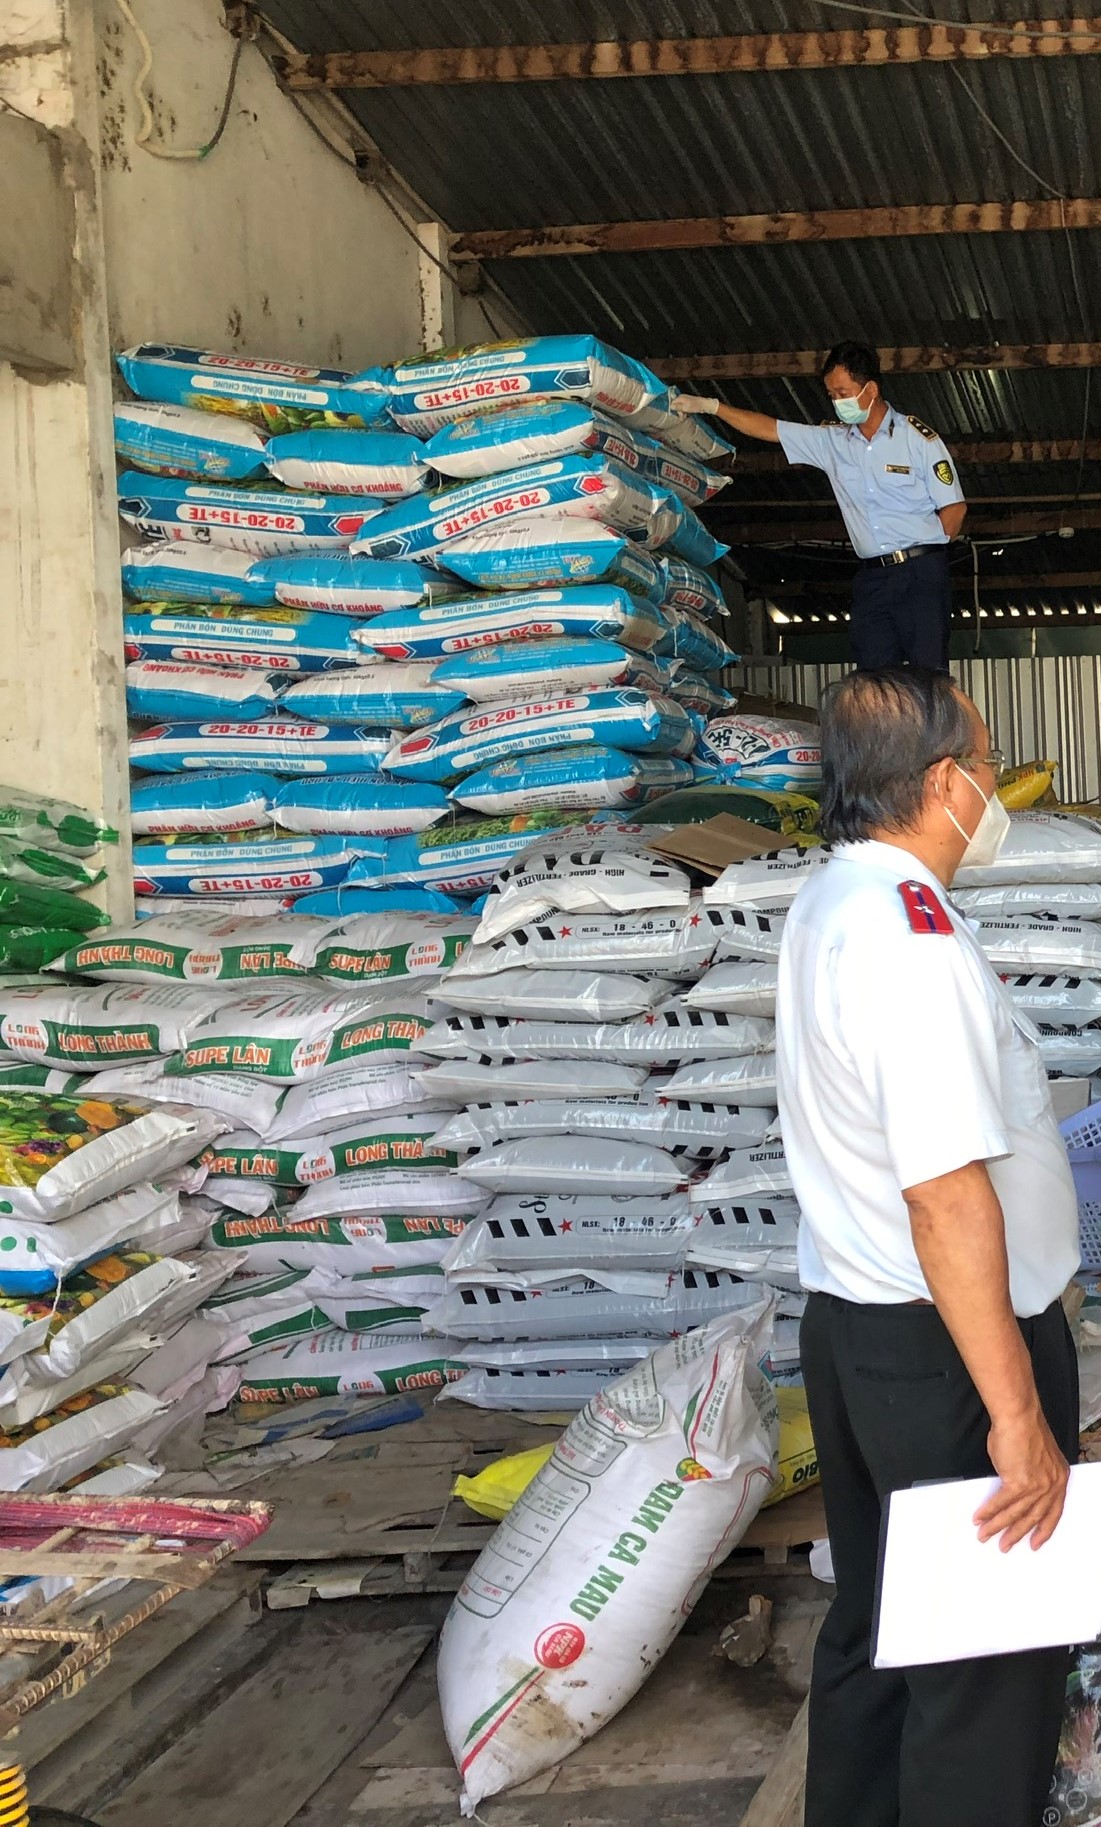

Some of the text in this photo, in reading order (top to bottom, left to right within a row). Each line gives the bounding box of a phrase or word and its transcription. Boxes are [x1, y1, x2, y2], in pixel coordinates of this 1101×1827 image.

[425, 378, 521, 407] 20-20-15+TE
[189, 506, 295, 530] 20-20-15+TE
[443, 492, 540, 535] 20-20-15+TE
[182, 650, 289, 668] 20-20-15+TE
[469, 698, 576, 731] 20-20-15+TE
[207, 724, 316, 736] 20-20-15+TE
[201, 873, 311, 891] 20-20-15+TE
[515, 868, 625, 888] HIGH GRADE FERTILIZER
[613, 922, 626, 932] 18
[979, 921, 1082, 933] HIGH GRADE FERTILIZE
[76, 944, 175, 969] LONG THÀNH
[411, 943, 438, 956] LONG
[240, 952, 271, 974] LÂN
[328, 951, 392, 974] SUPE LÂN
[7, 1023, 40, 1036] LONG
[57, 1029, 153, 1053] LONG THÀNH
[340, 1017, 427, 1050] LONG THÀN
[184, 1041, 271, 1069] SUPE LÂN
[240, 1152, 279, 1177] LÂN
[344, 1141, 390, 1168] LONG
[224, 1215, 284, 1239] THÀNH
[402, 1216, 442, 1237] LÂN
[581, 1220, 601, 1229] NLSX:
[612, 1216, 626, 1227] 18
[641, 1216, 655, 1227] 46
[394, 1369, 443, 1393] LONG
[607, 1531, 648, 1567] CÀ
[568, 1564, 626, 1623] MAU
[553, 1631, 573, 1657] NPK
